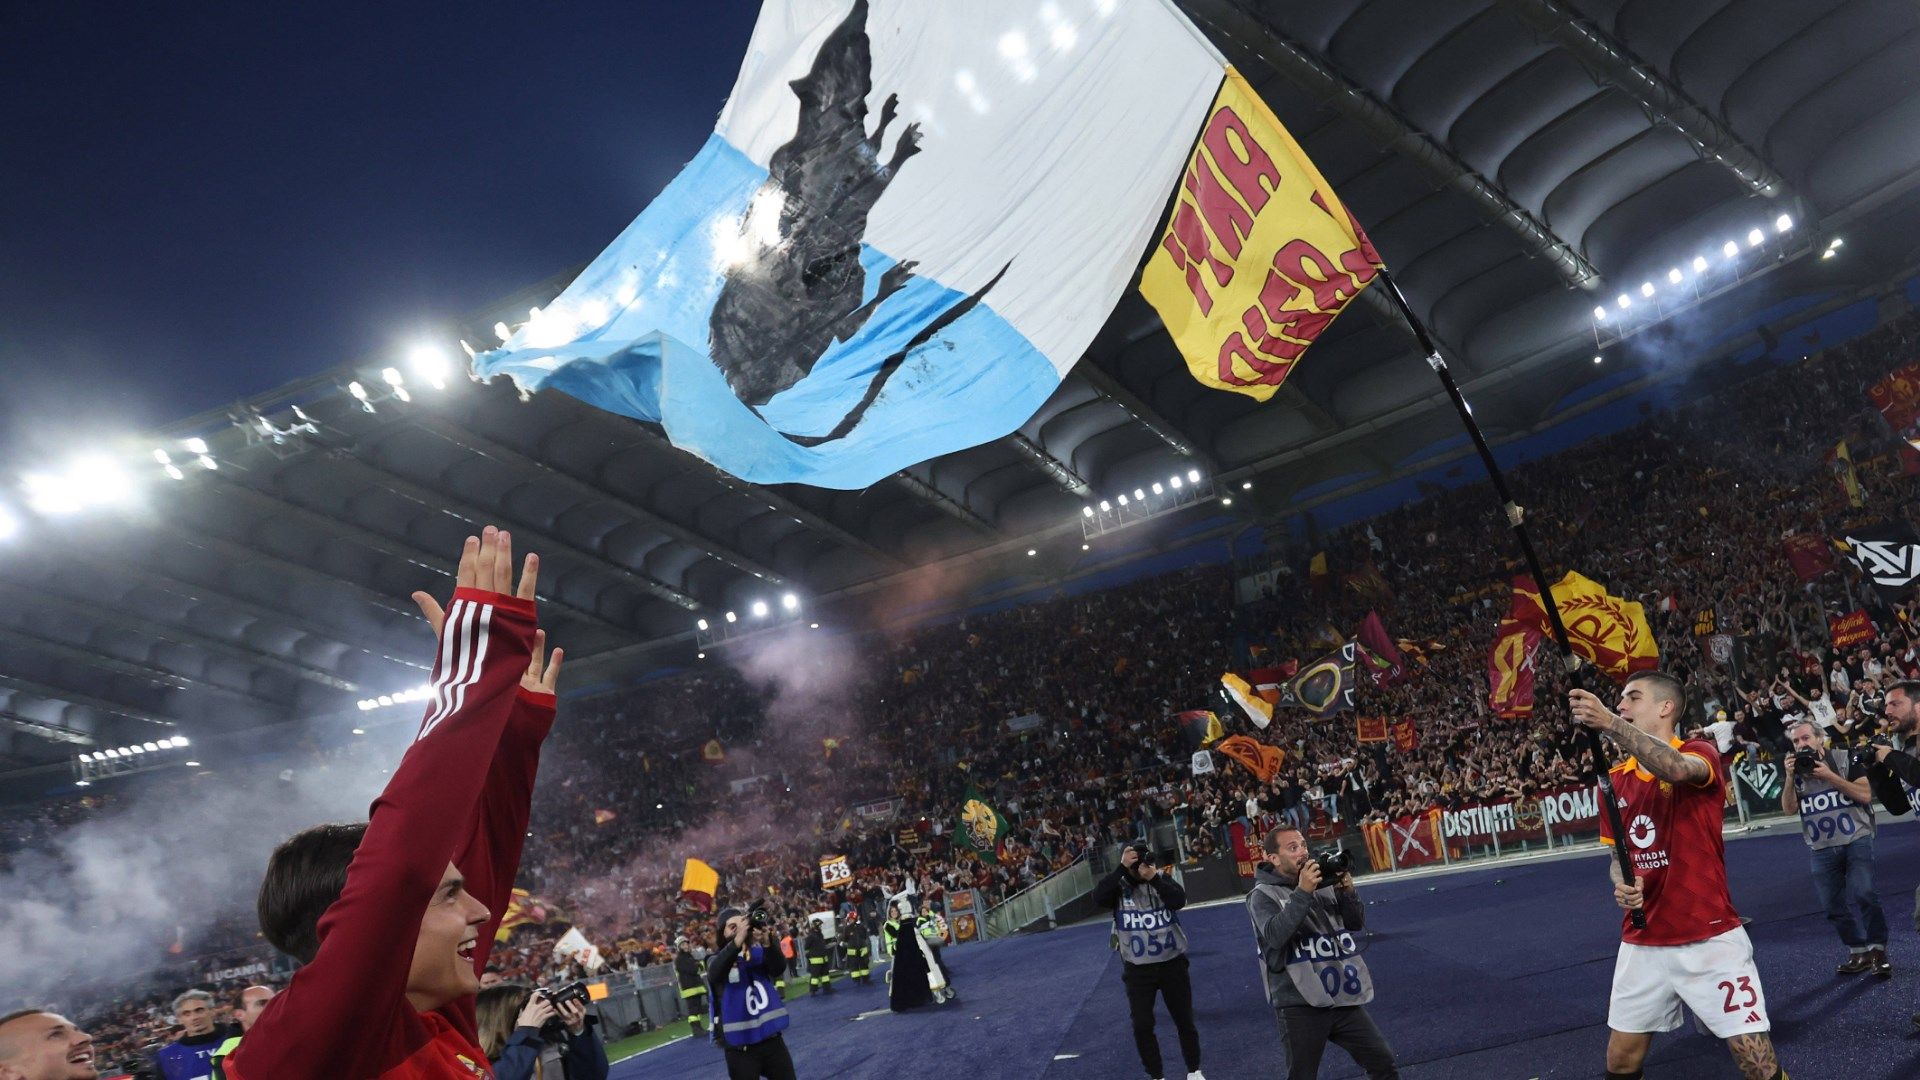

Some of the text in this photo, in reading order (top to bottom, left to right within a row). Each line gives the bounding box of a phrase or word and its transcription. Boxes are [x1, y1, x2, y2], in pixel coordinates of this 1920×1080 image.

[1443, 802, 1516, 838] DISTINTI
[1804, 812, 1856, 843] 090
[1634, 850, 1667, 862] RIYADH
[1636, 858, 1669, 869] SEASON
[1122, 908, 1172, 930] PHOTO
[1129, 930, 1177, 958] 054
[1717, 975, 1758, 1014] 23
[195, 1048, 217, 1059] TV
